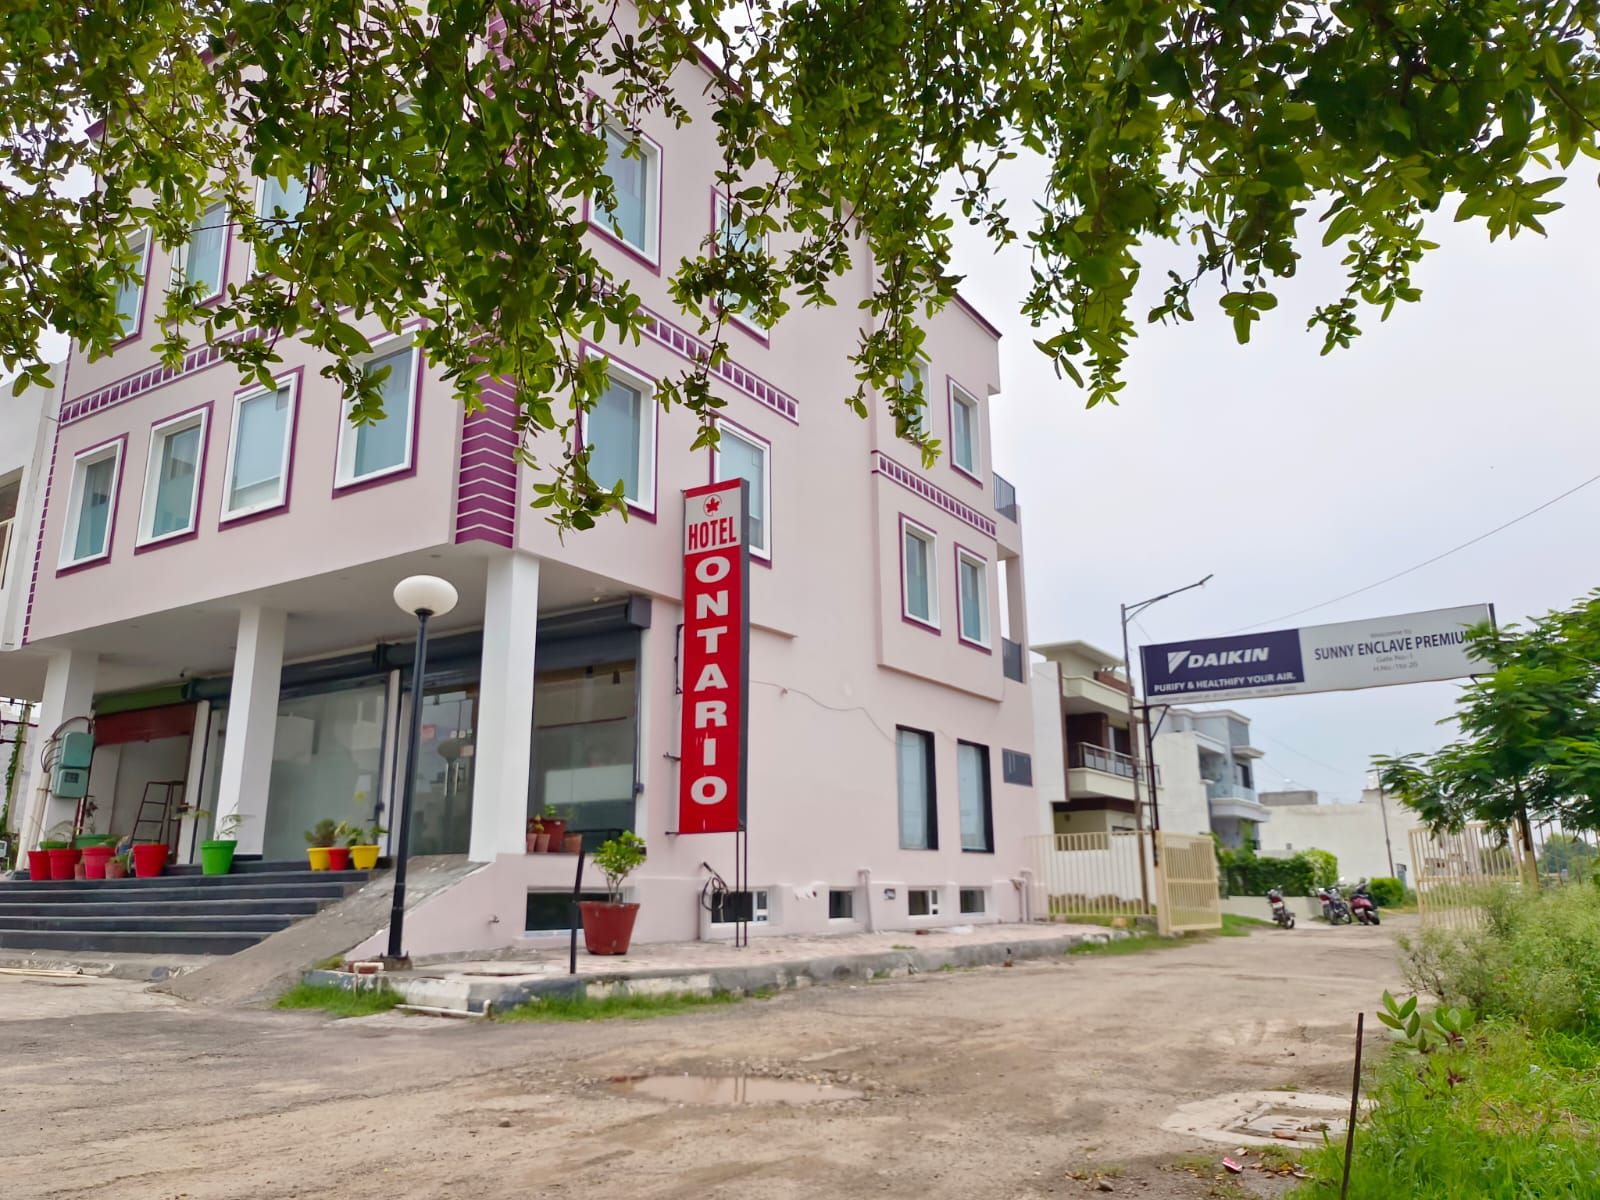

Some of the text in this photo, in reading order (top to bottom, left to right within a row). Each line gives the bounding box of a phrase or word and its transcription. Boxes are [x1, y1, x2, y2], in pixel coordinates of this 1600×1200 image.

[688, 516, 737, 551] HOTEL
[1187, 647, 1270, 669] DAIKIN
[1315, 644, 1354, 661] SUNNY
[1358, 637, 1413, 656] ENCLAVE
[691, 555, 731, 806] ONTARIO
[1154, 672, 1296, 692] PURIFY & HEALTHIFY YOUR AIR.
